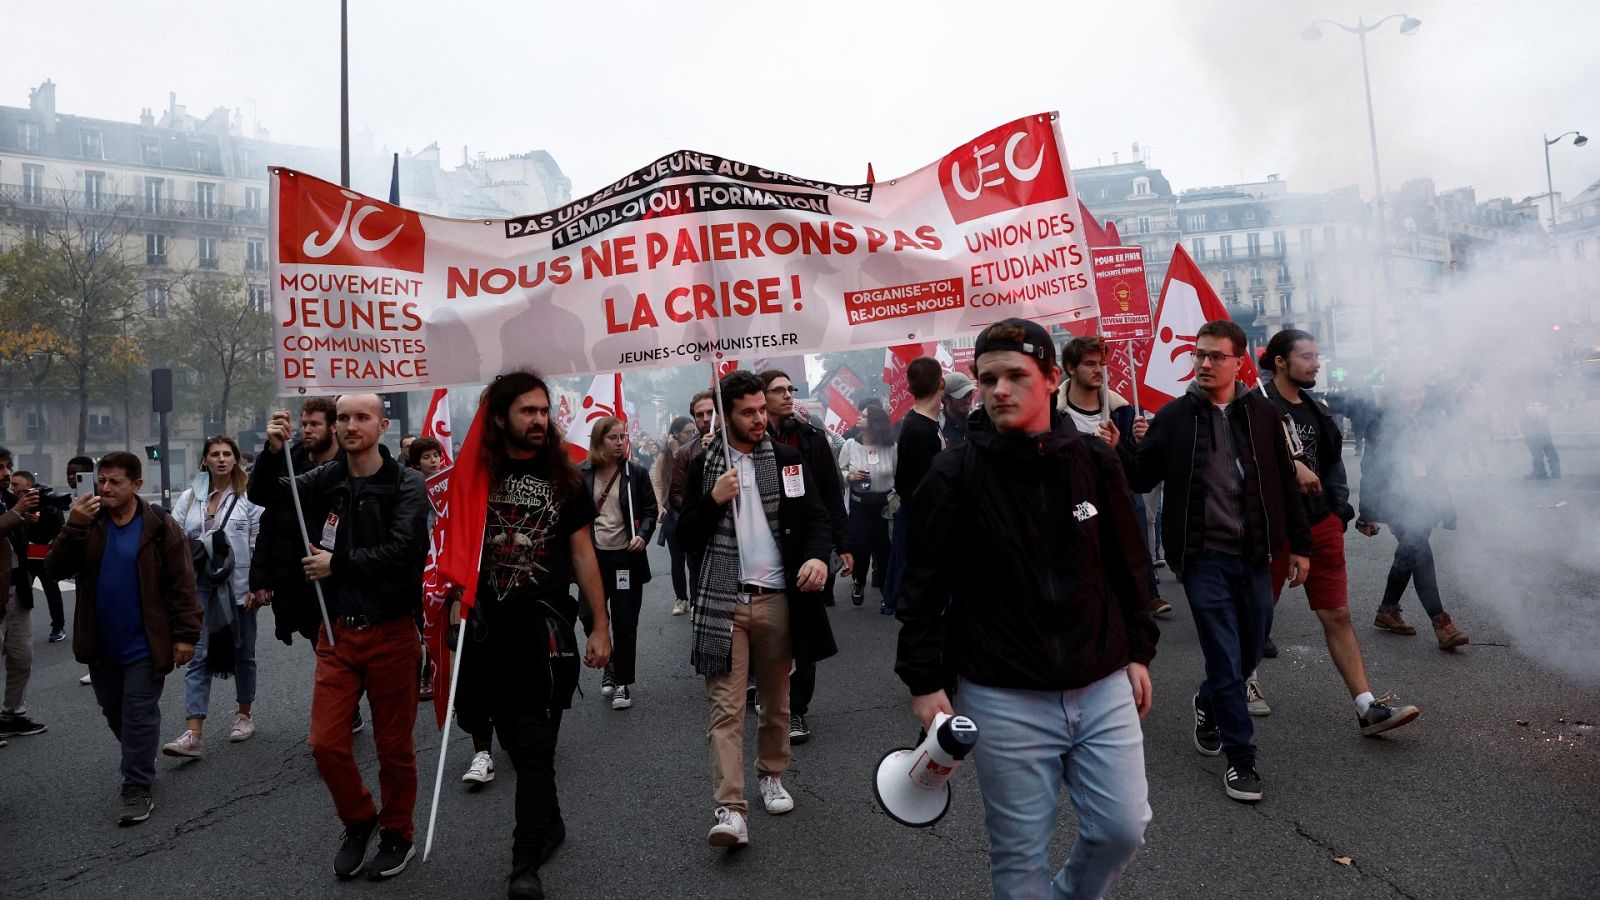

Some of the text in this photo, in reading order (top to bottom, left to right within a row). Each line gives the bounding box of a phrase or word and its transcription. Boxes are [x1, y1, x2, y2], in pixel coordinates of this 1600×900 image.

[952, 132, 1044, 200] UEC
[508, 216, 553, 236] PAS
[557, 200, 588, 223] UN
[591, 175, 640, 206] SEUL
[642, 153, 714, 181] JEUNE
[717, 160, 749, 176] AU
[649, 189, 681, 211] OU
[685, 187, 695, 208] 1
[699, 186, 826, 212] FORMATION
[964, 213, 1075, 254] UNION DES
[446, 220, 943, 299] NOUS NE PAIERONS PAS
[970, 244, 1083, 288] ETUDIANTS
[280, 273, 423, 297] MOUVEMENT
[970, 273, 1088, 308] COMMUNISTES
[282, 297, 423, 332] JEUNES
[604, 292, 658, 335] LA
[664, 276, 784, 323] CRISE
[284, 336, 426, 354] COMMUNISTES
[618, 333, 798, 364] JEUNES-COMMUNISTES.FR
[284, 357, 429, 379] DE FRANCE
